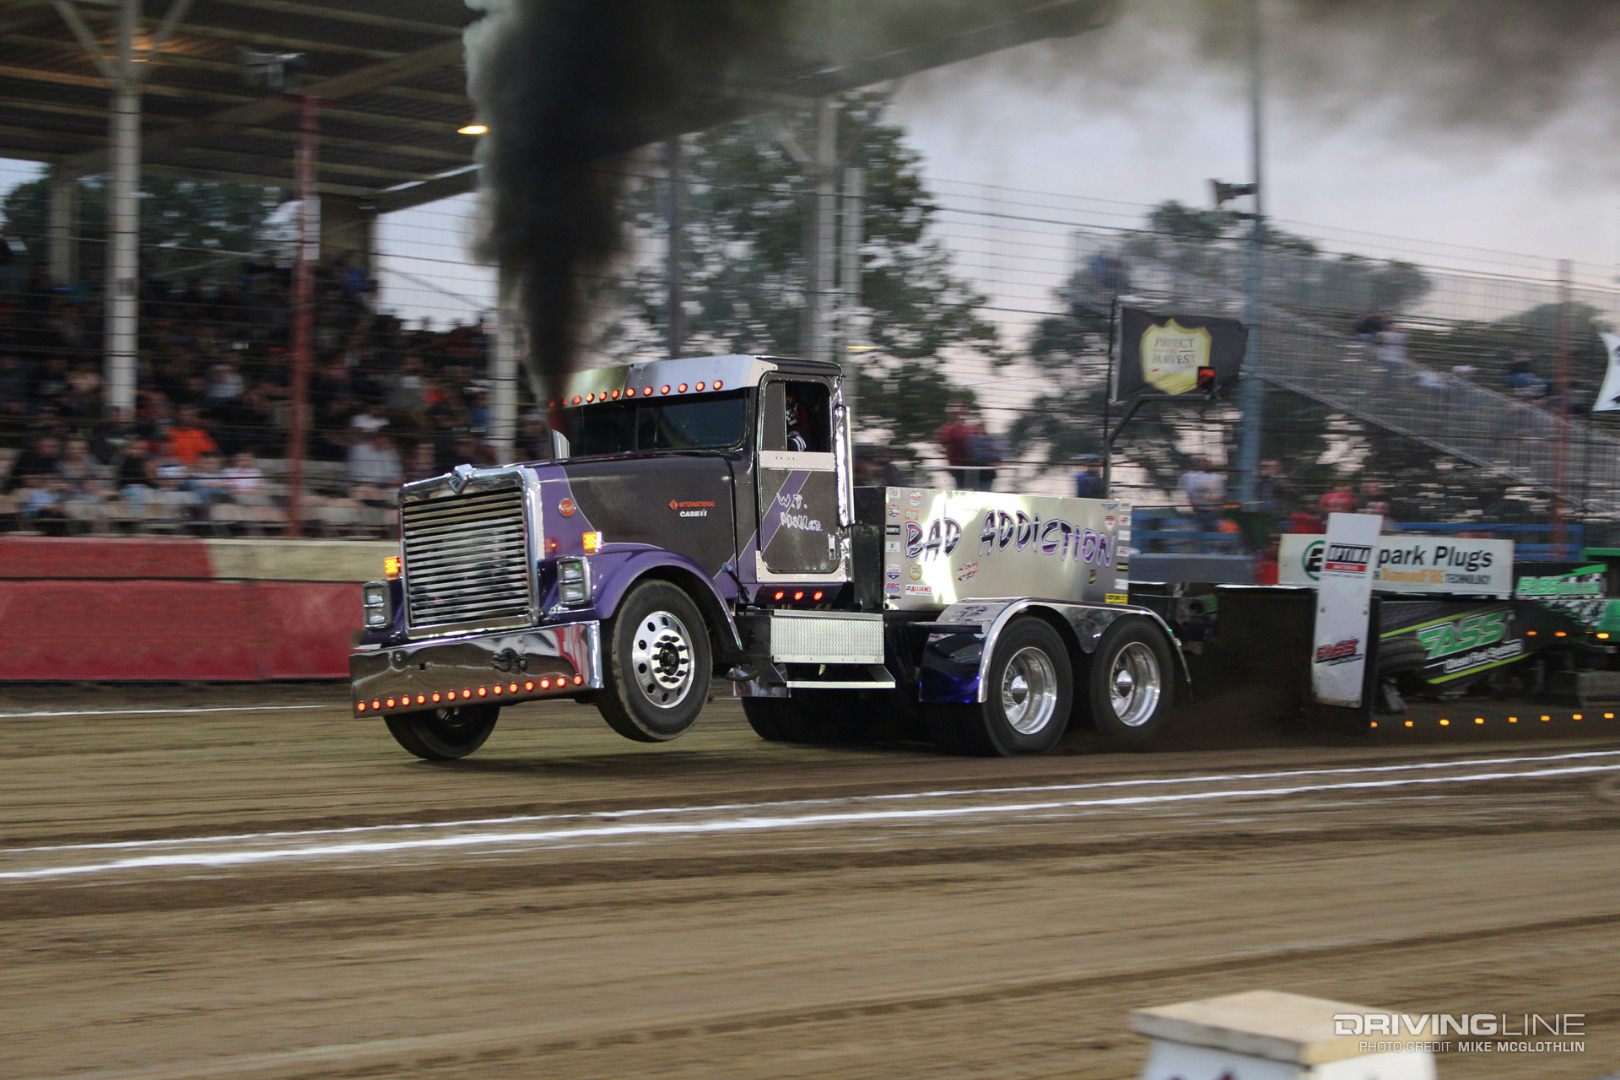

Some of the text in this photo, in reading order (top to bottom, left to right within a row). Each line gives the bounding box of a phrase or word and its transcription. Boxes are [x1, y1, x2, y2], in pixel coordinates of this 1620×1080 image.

[905, 509, 1116, 567] BAD ADDICTION
[1377, 545, 1426, 569] park
[1432, 546, 1493, 572] Plugs
[1418, 609, 1508, 660] FASS
